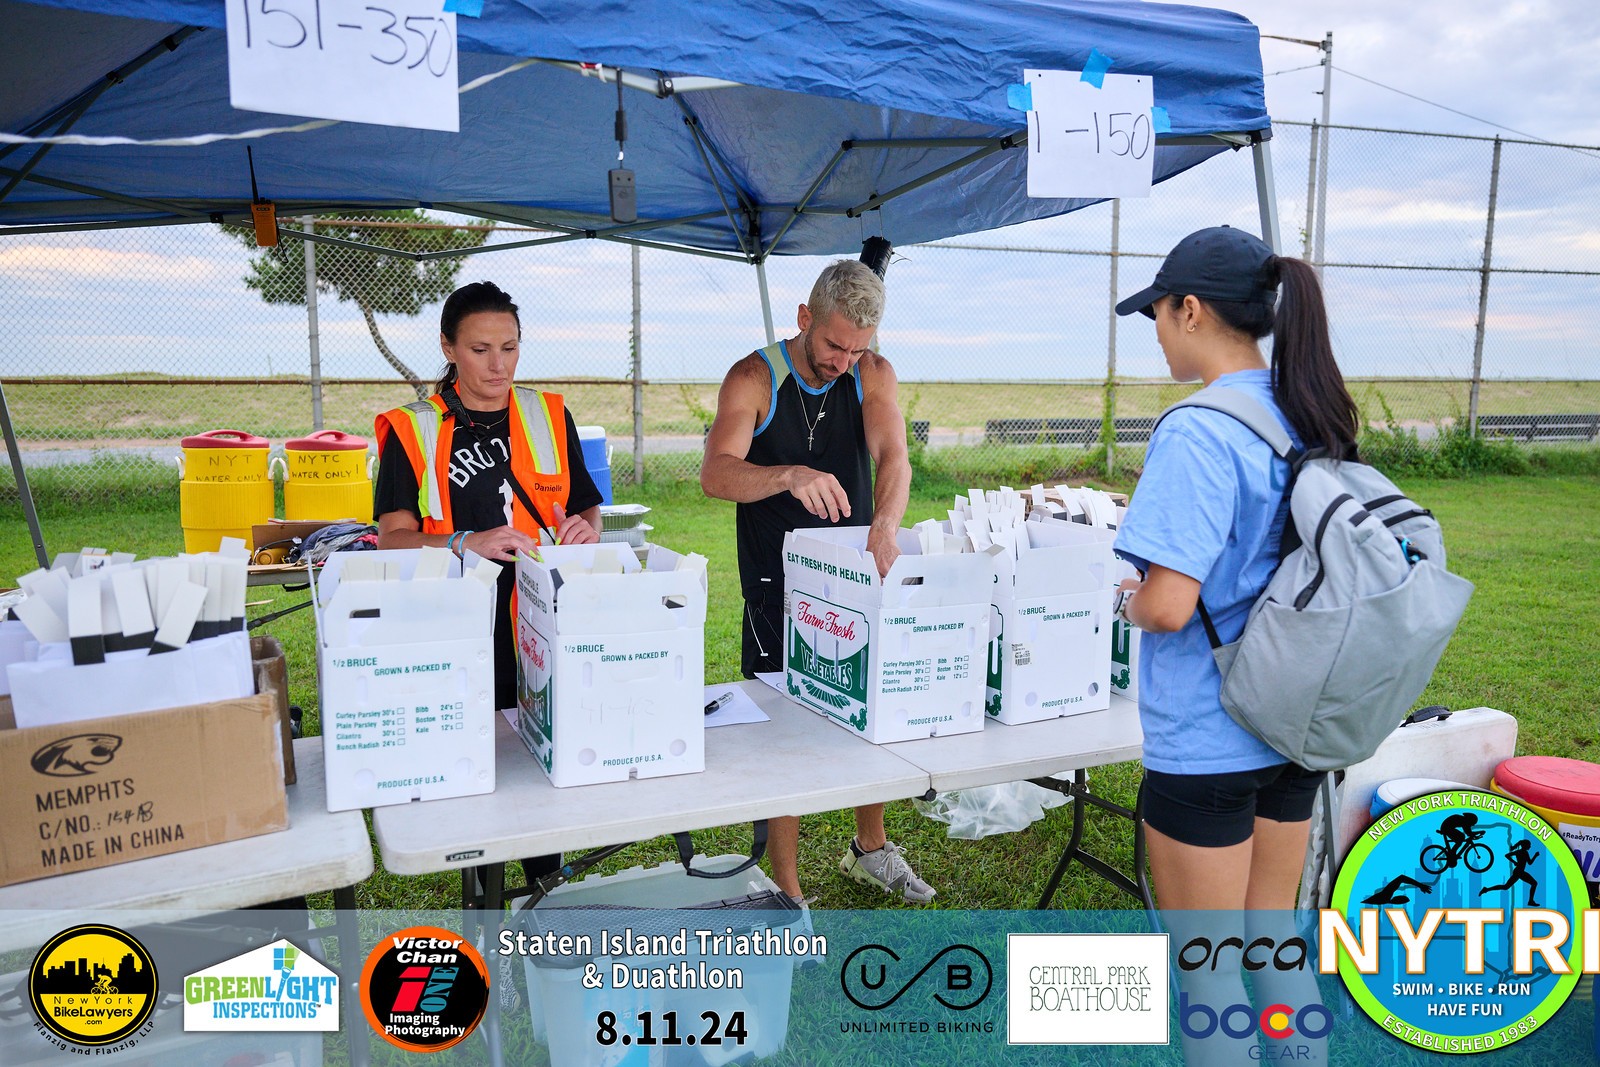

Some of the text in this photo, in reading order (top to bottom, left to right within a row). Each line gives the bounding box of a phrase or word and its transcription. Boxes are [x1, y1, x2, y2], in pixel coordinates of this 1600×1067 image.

[209, 454, 252, 467] NYT
[298, 454, 339, 465] NYTC
[196, 474, 230, 482] WATER
[291, 471, 320, 479] WATER
[534, 482, 563, 492] Danielle
[787, 552, 871, 586] EAT FRESH FOR HEALTH
[1026, 606, 1046, 615] BRUCE
[797, 600, 825, 630] Farm
[824, 611, 856, 641] Fresh
[894, 617, 916, 625] BRUCE
[1043, 614, 1061, 622] GROWN
[1066, 611, 1084, 619] PACKED
[938, 623, 957, 631] PACKED
[577, 644, 604, 653] BRUCE
[601, 654, 626, 662] GROWN
[628, 653, 633, 661] &
[635, 652, 659, 660] PACKED
[347, 657, 377, 667] BRUCE
[374, 667, 402, 676] GROWN
[404, 666, 410, 674] &
[412, 663, 440, 672] PACKED
[1041, 699, 1063, 708] PRODUCE
[336, 712, 356, 720] Curley
[358, 711, 381, 719] Parsley
[415, 715, 436, 723] Boston
[354, 721, 377, 729] Parsley
[907, 718, 931, 726] PRODUCE
[416, 726, 429, 734] Kale
[603, 758, 633, 766] PRODUCE
[645, 755, 664, 763] U.S.A.
[377, 775, 447, 789] PRODUCE OF U.S.A.
[41, 824, 185, 868] MADE IN CHINA
